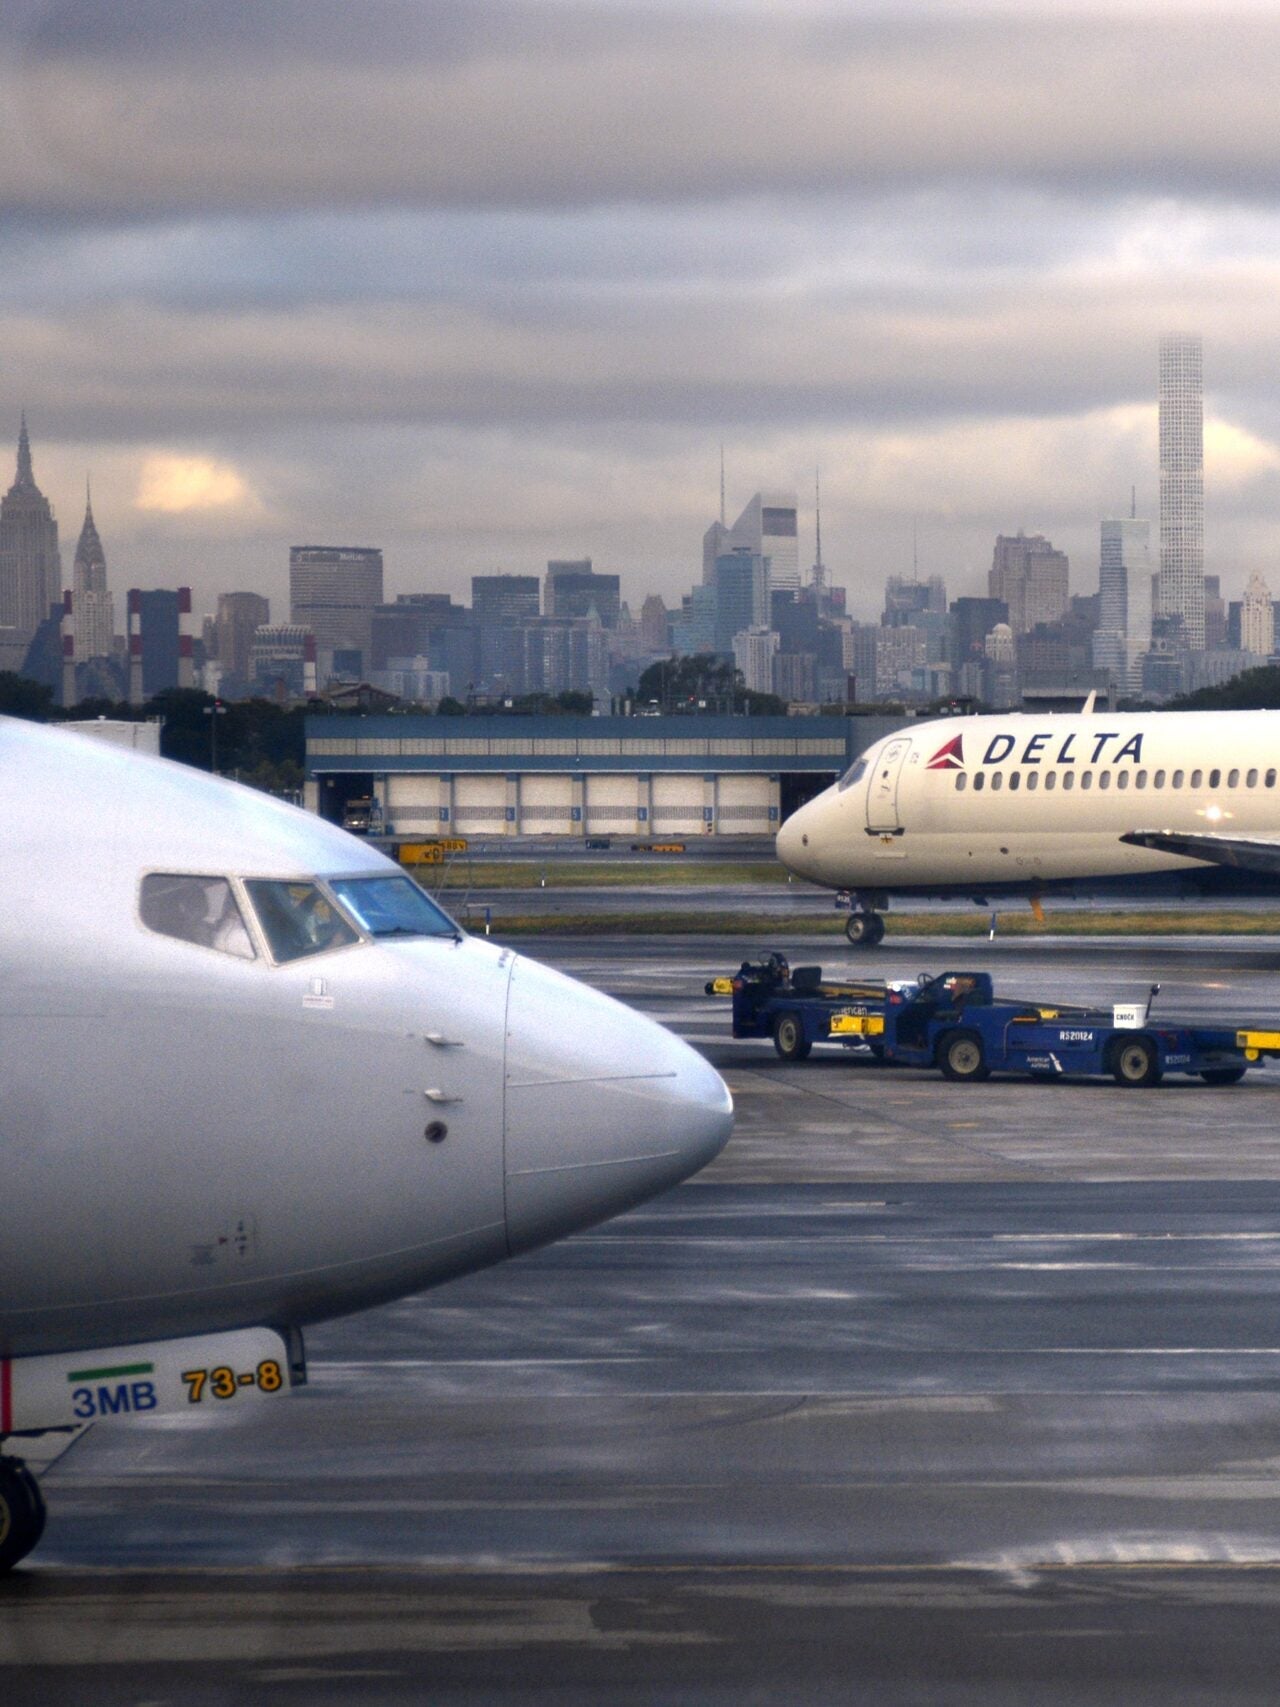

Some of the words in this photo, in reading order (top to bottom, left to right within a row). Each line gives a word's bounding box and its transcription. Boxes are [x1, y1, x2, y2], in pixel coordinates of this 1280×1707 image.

[981, 732, 1145, 765] DELTA
[1059, 1031, 1093, 1041] RS20124
[181, 1359, 284, 1404] 73-8
[72, 1381, 157, 1418] 3MB
